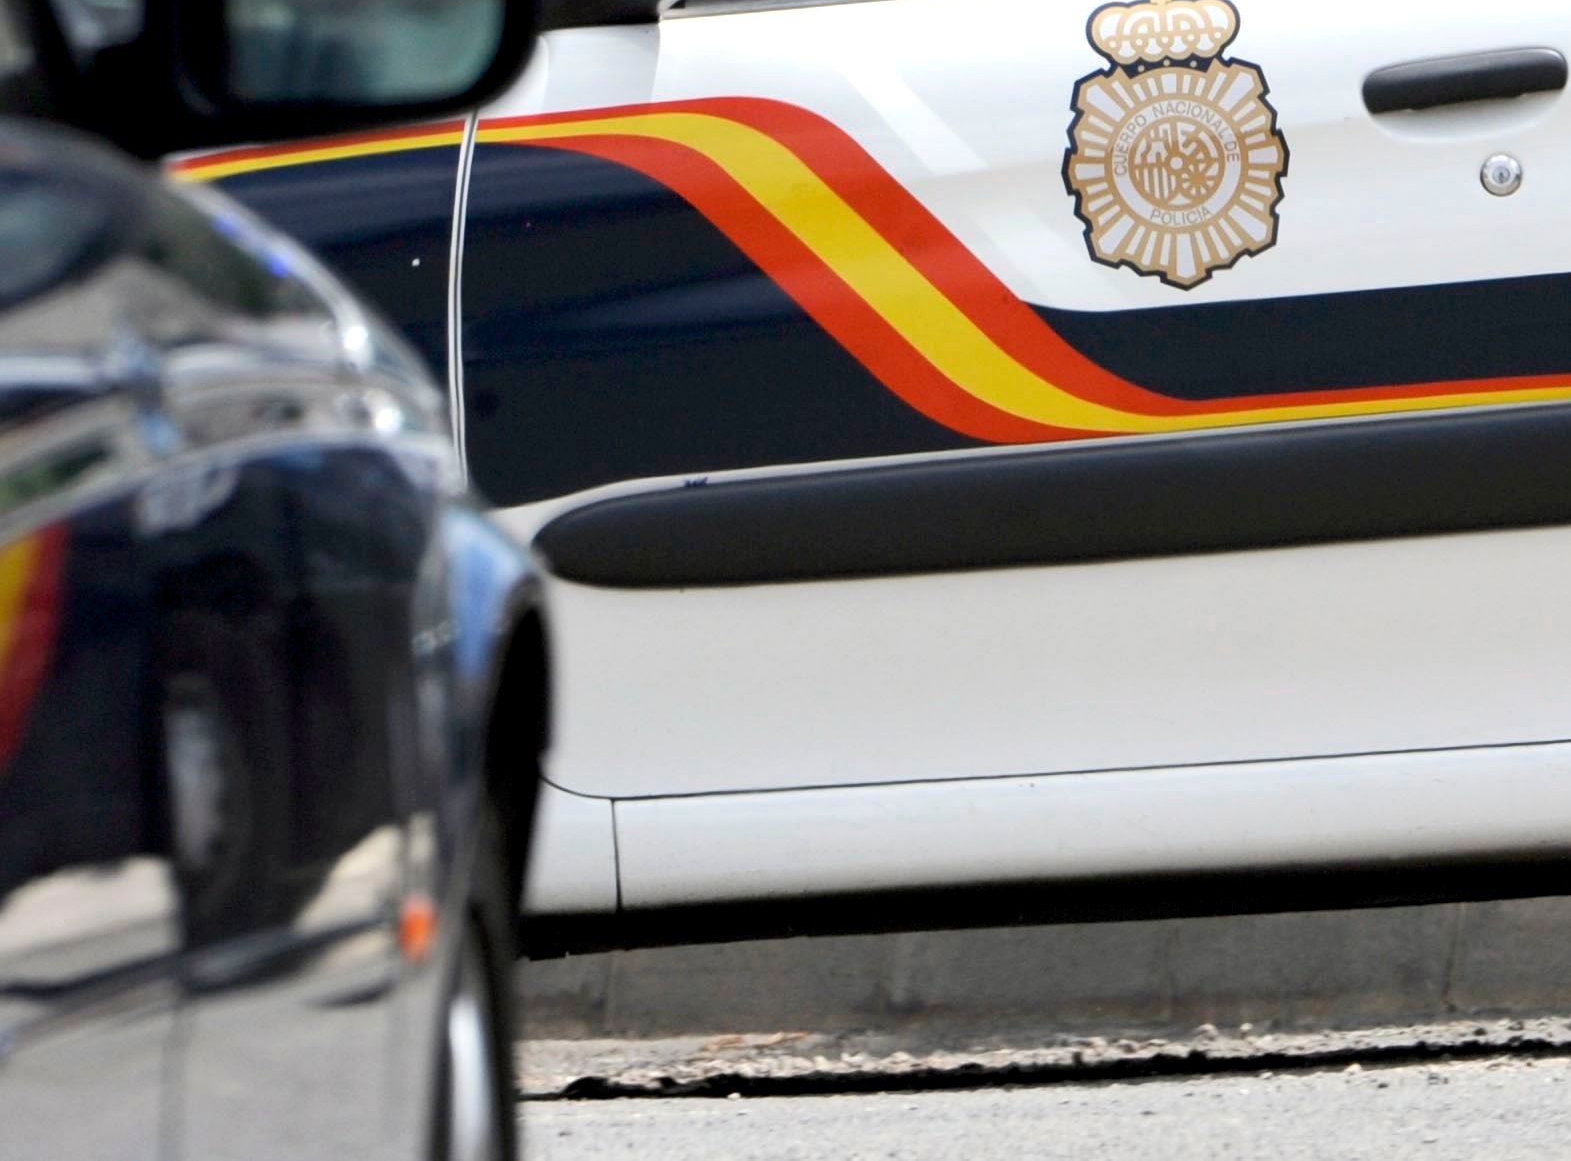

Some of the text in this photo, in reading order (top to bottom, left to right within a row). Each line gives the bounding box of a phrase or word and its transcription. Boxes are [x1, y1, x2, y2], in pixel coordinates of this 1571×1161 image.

[1114, 100, 1240, 177] CUERPO NACIONAL DE
[1150, 205, 1211, 226] POLICIA
